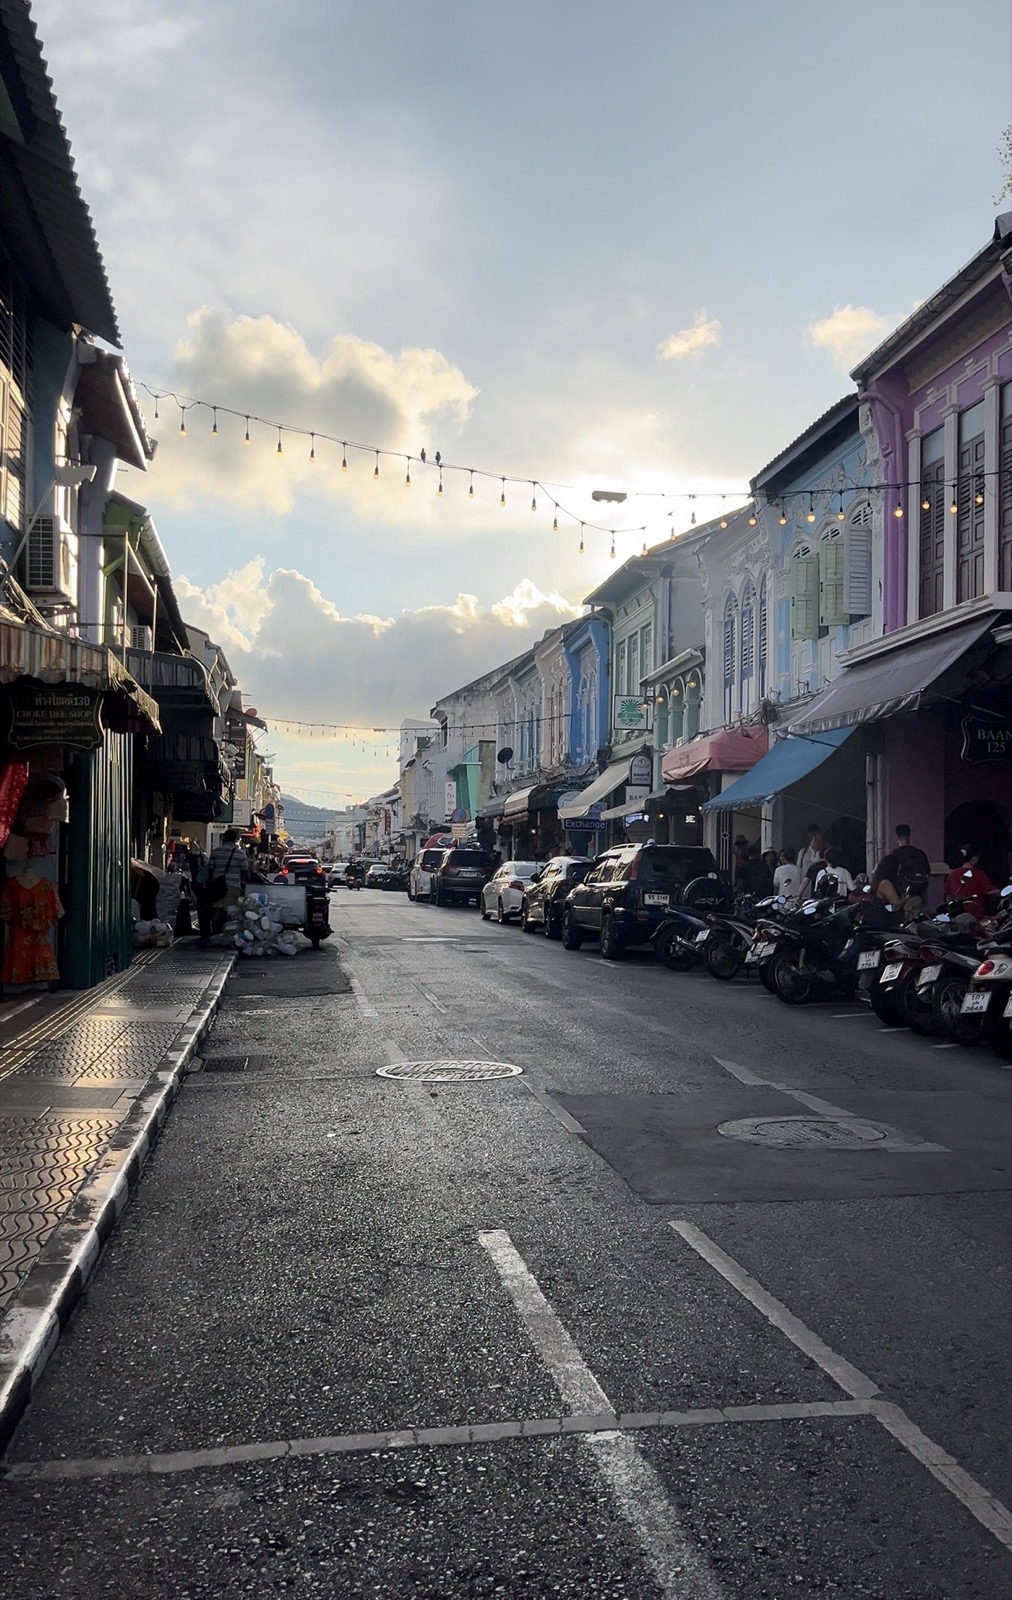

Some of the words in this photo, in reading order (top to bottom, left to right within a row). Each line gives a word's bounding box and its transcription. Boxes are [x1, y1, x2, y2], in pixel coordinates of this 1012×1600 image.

[16, 710, 47, 718] CHOKE
[69, 710, 92, 718] SHOP
[987, 741, 1006, 753] 125
[565, 819, 606, 829] Exchange
